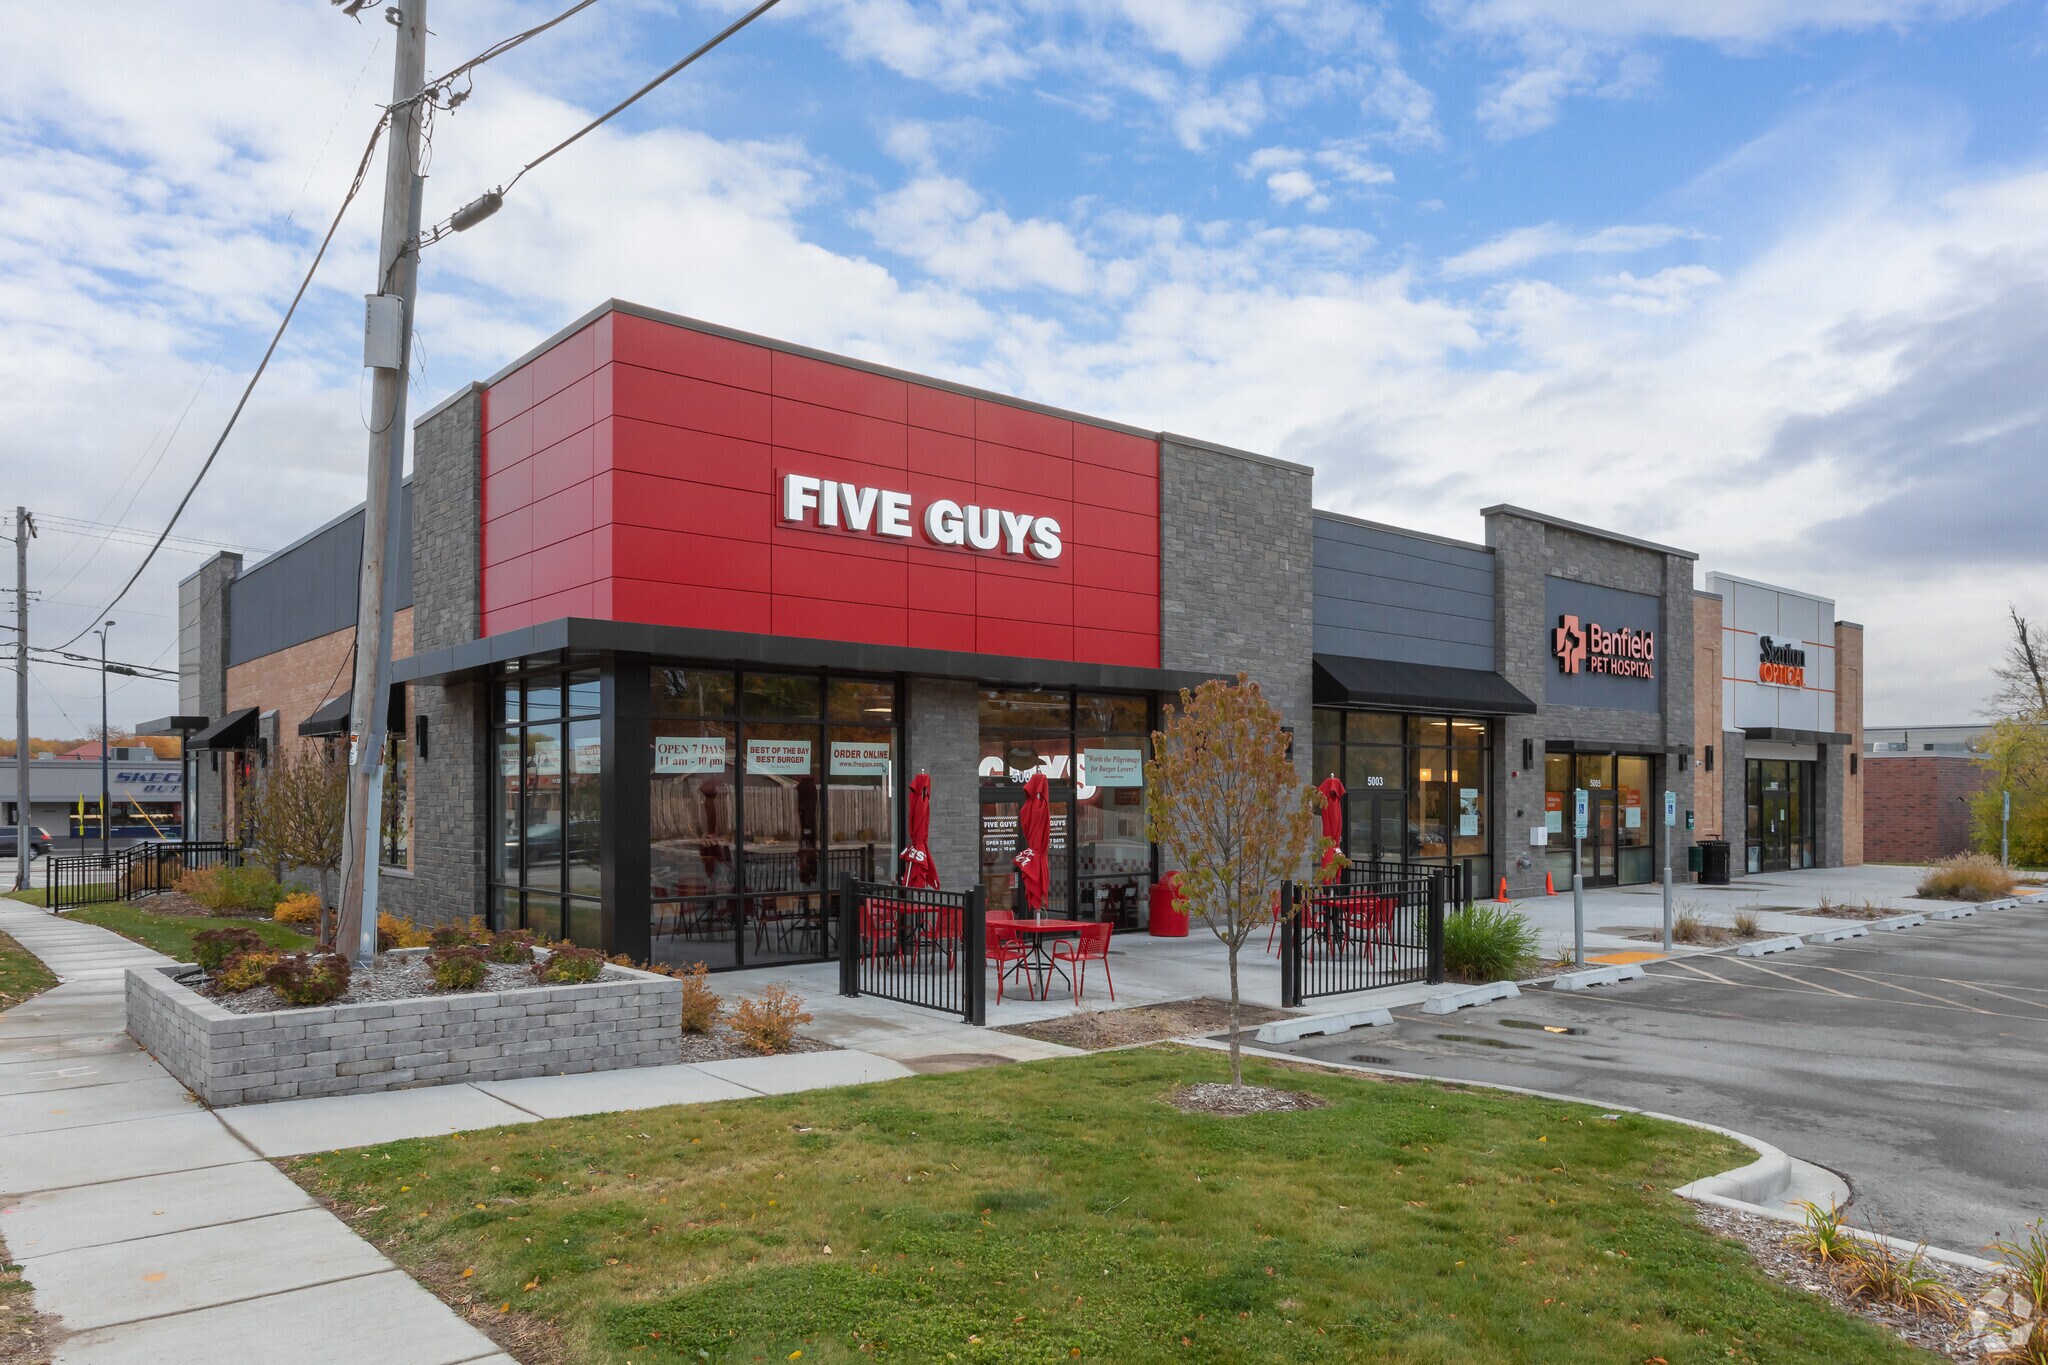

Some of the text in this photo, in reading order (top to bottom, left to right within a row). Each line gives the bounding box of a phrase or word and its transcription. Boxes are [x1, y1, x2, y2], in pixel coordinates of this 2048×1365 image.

[784, 473, 1063, 560] FIVE GUYS
[1588, 623, 1655, 661] Banfield
[1760, 635, 1806, 668] Stanton
[1590, 656, 1655, 680] PET HOSPITAL
[1759, 661, 1807, 688] OPTICAL
[658, 743, 725, 754] OPEN 7 DAYS
[750, 746, 770, 754] BEST
[783, 747, 796, 755] THE
[797, 747, 810, 755] BAY
[833, 749, 888, 759] ORDER ONLINE
[660, 756, 669, 765] 11
[698, 757, 707, 765] 10
[709, 758, 723, 768] pm
[756, 755, 804, 764] BEST BURGER
[1367, 776, 1384, 786] 5003
[1590, 779, 1601, 788] 5005
